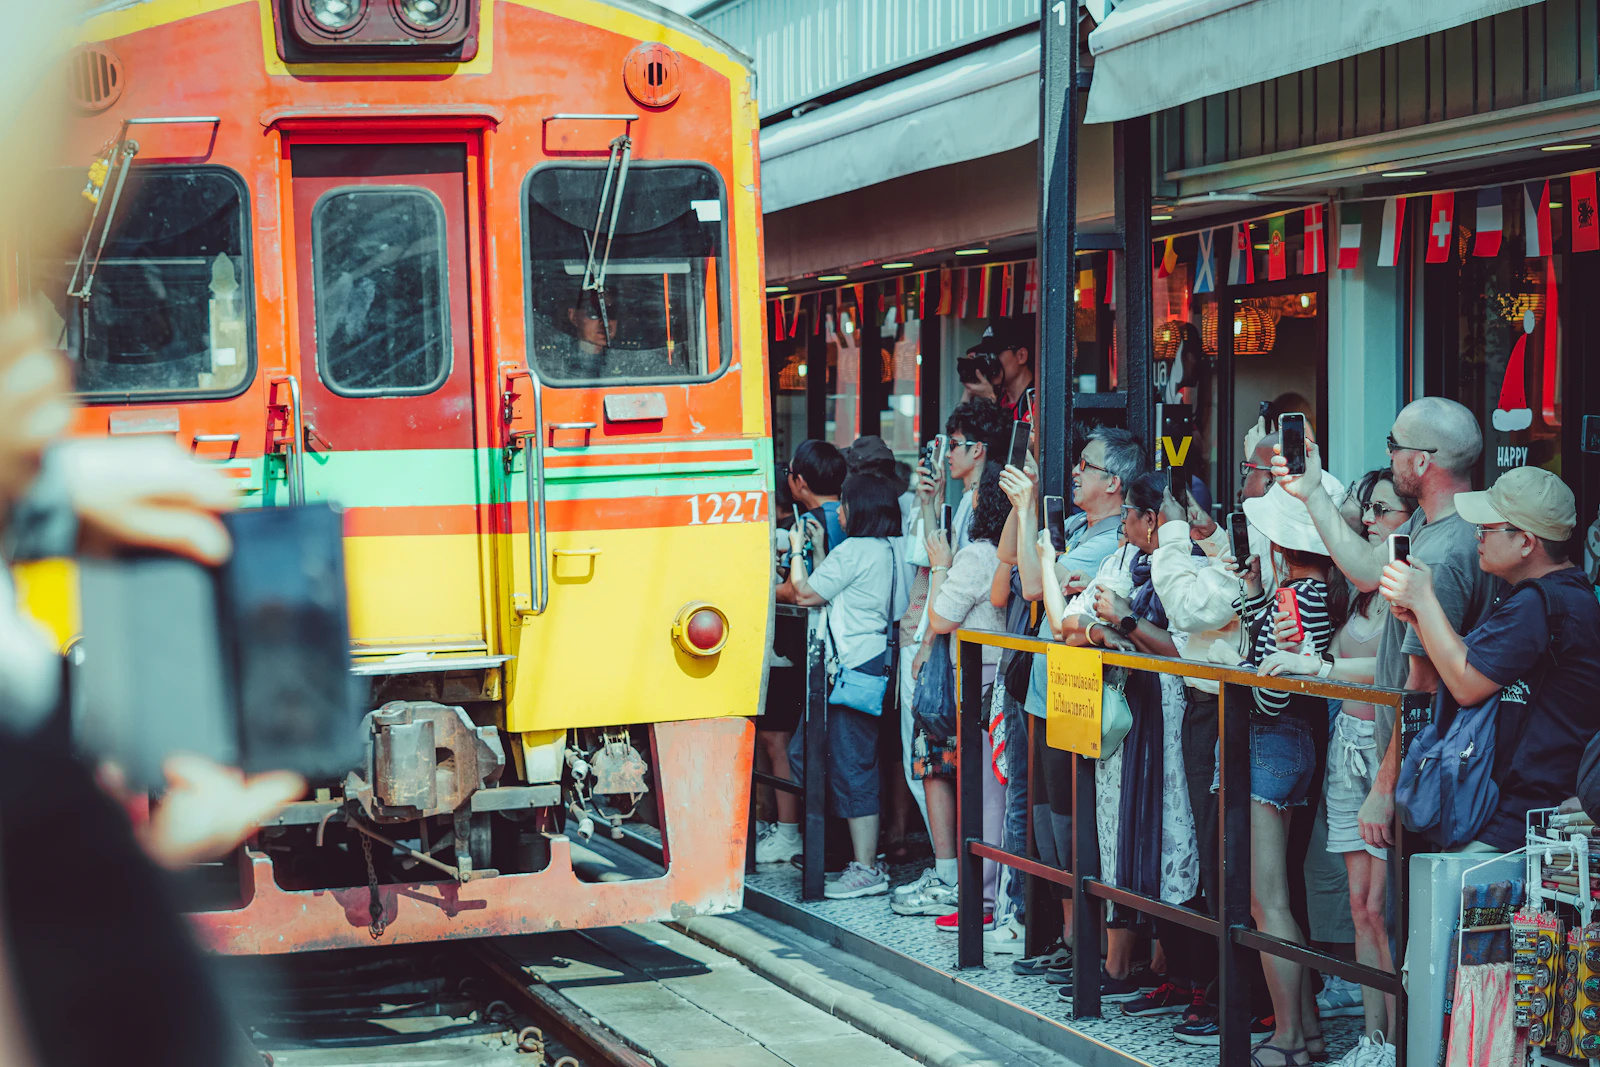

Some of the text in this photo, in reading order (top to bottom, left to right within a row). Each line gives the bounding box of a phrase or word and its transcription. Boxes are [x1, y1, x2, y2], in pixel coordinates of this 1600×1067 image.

[1051, 1, 1066, 26] 1
[1497, 446, 1528, 467] HAPPY
[686, 492, 763, 526] 1227
